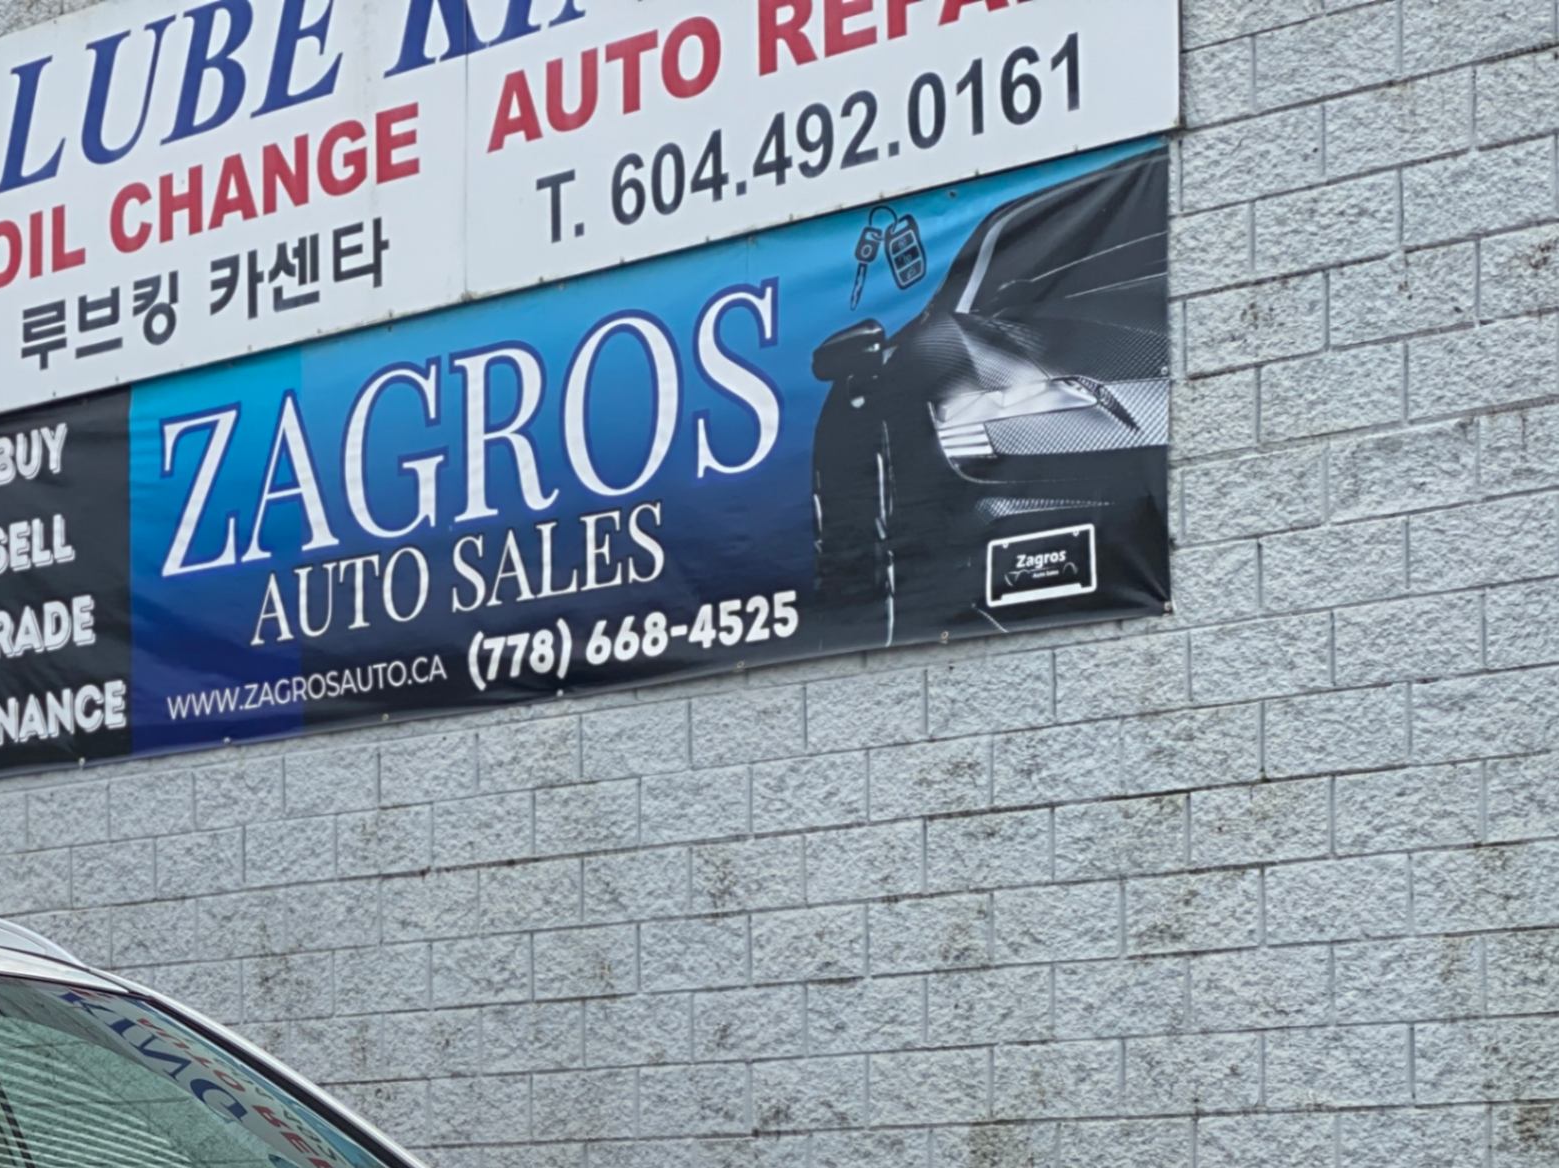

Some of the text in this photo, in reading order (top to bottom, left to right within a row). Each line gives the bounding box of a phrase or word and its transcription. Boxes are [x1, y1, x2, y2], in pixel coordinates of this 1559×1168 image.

[487, 16, 722, 153] AUTO
[536, 168, 586, 245] T.
[610, 32, 1081, 227] 604.492.0161
[109, 101, 421, 254] CHANGE
[20, 216, 390, 371] 루브킹 카센타
[158, 279, 784, 579] ZAGROS
[250, 502, 666, 647] AUTO SALES
[1015, 549, 1067, 570] Zagros
[166, 654, 448, 721] WWW.ZAGROSAUTO.CA
[466, 589, 799, 691] (778) 668-4525
